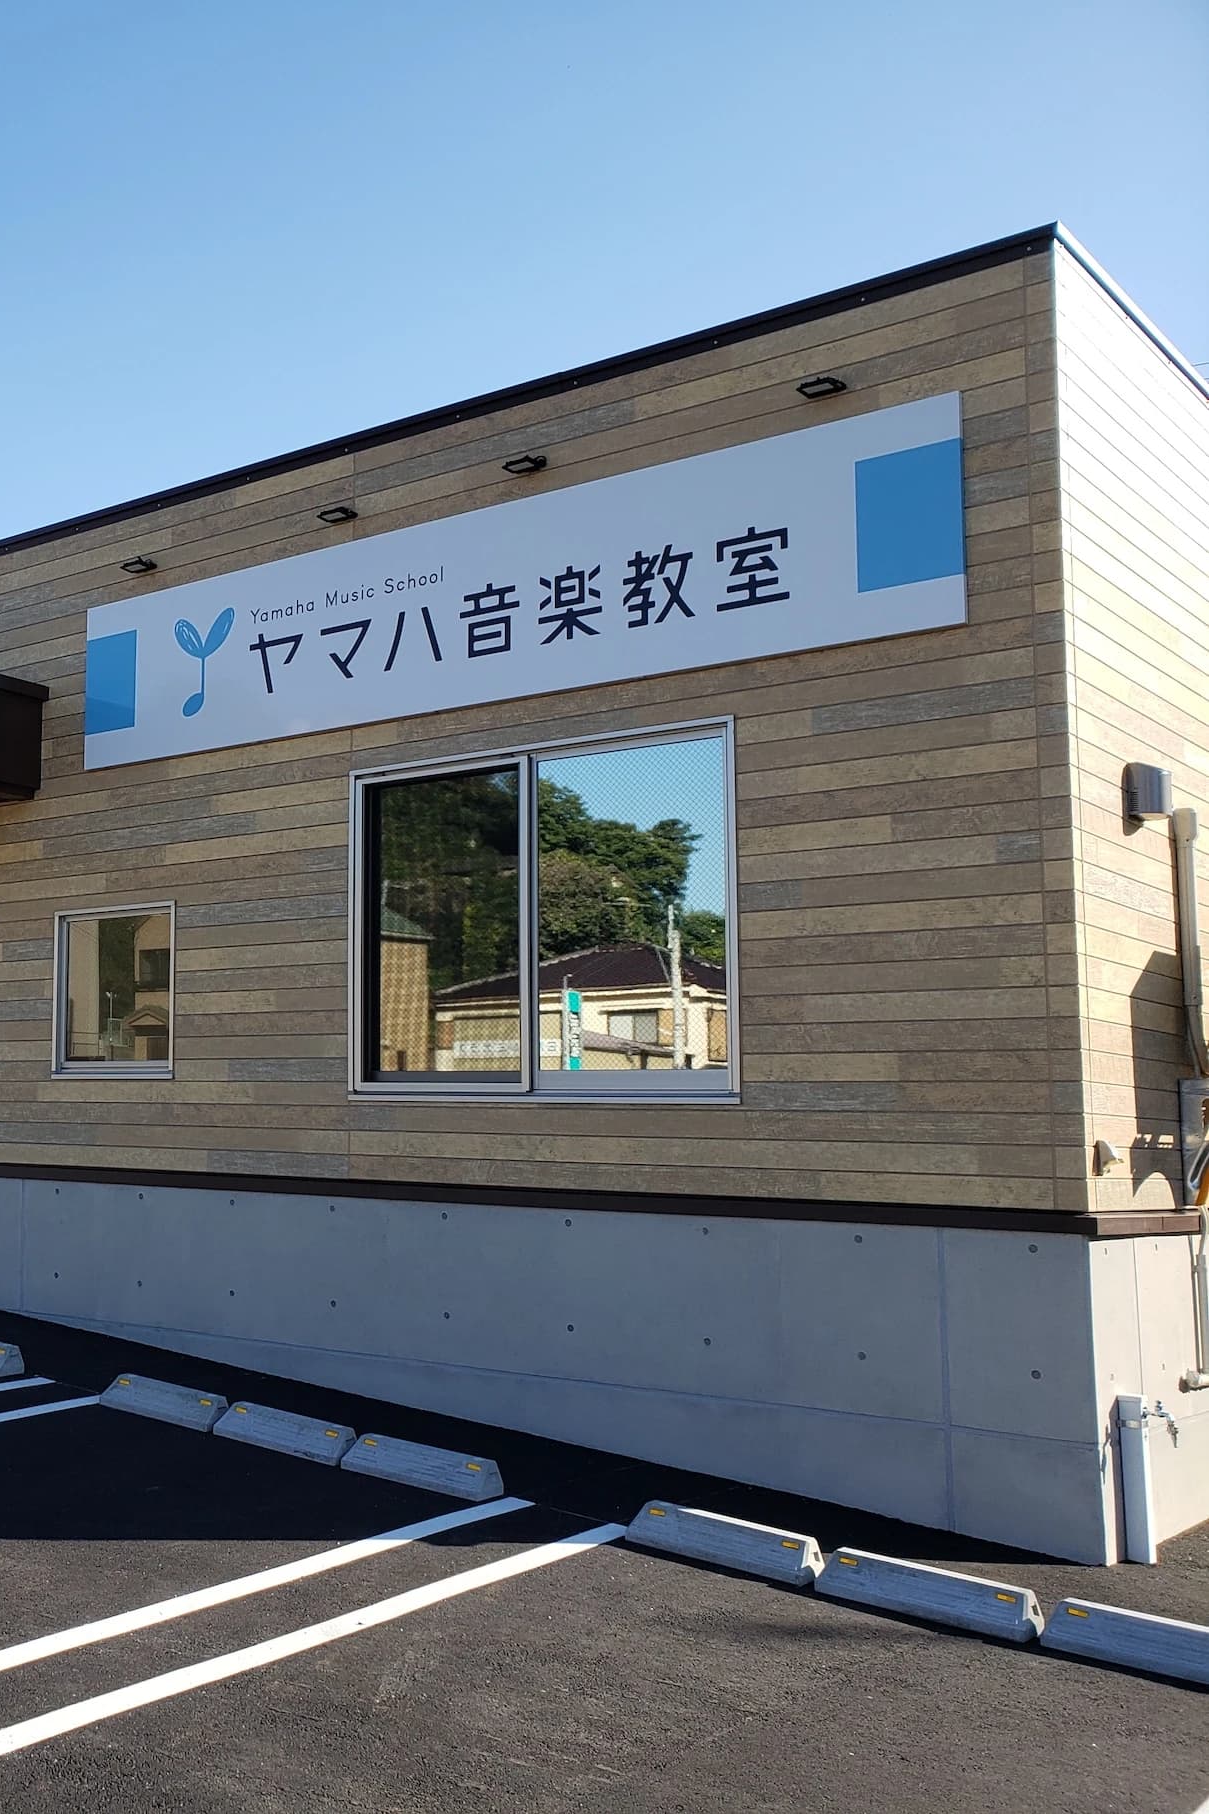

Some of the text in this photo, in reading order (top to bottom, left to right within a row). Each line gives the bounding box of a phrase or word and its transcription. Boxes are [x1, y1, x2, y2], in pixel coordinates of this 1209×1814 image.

[248, 526, 791, 694] ヤマハ音楽教室
[250, 565, 444, 625] Yamaha Music School
